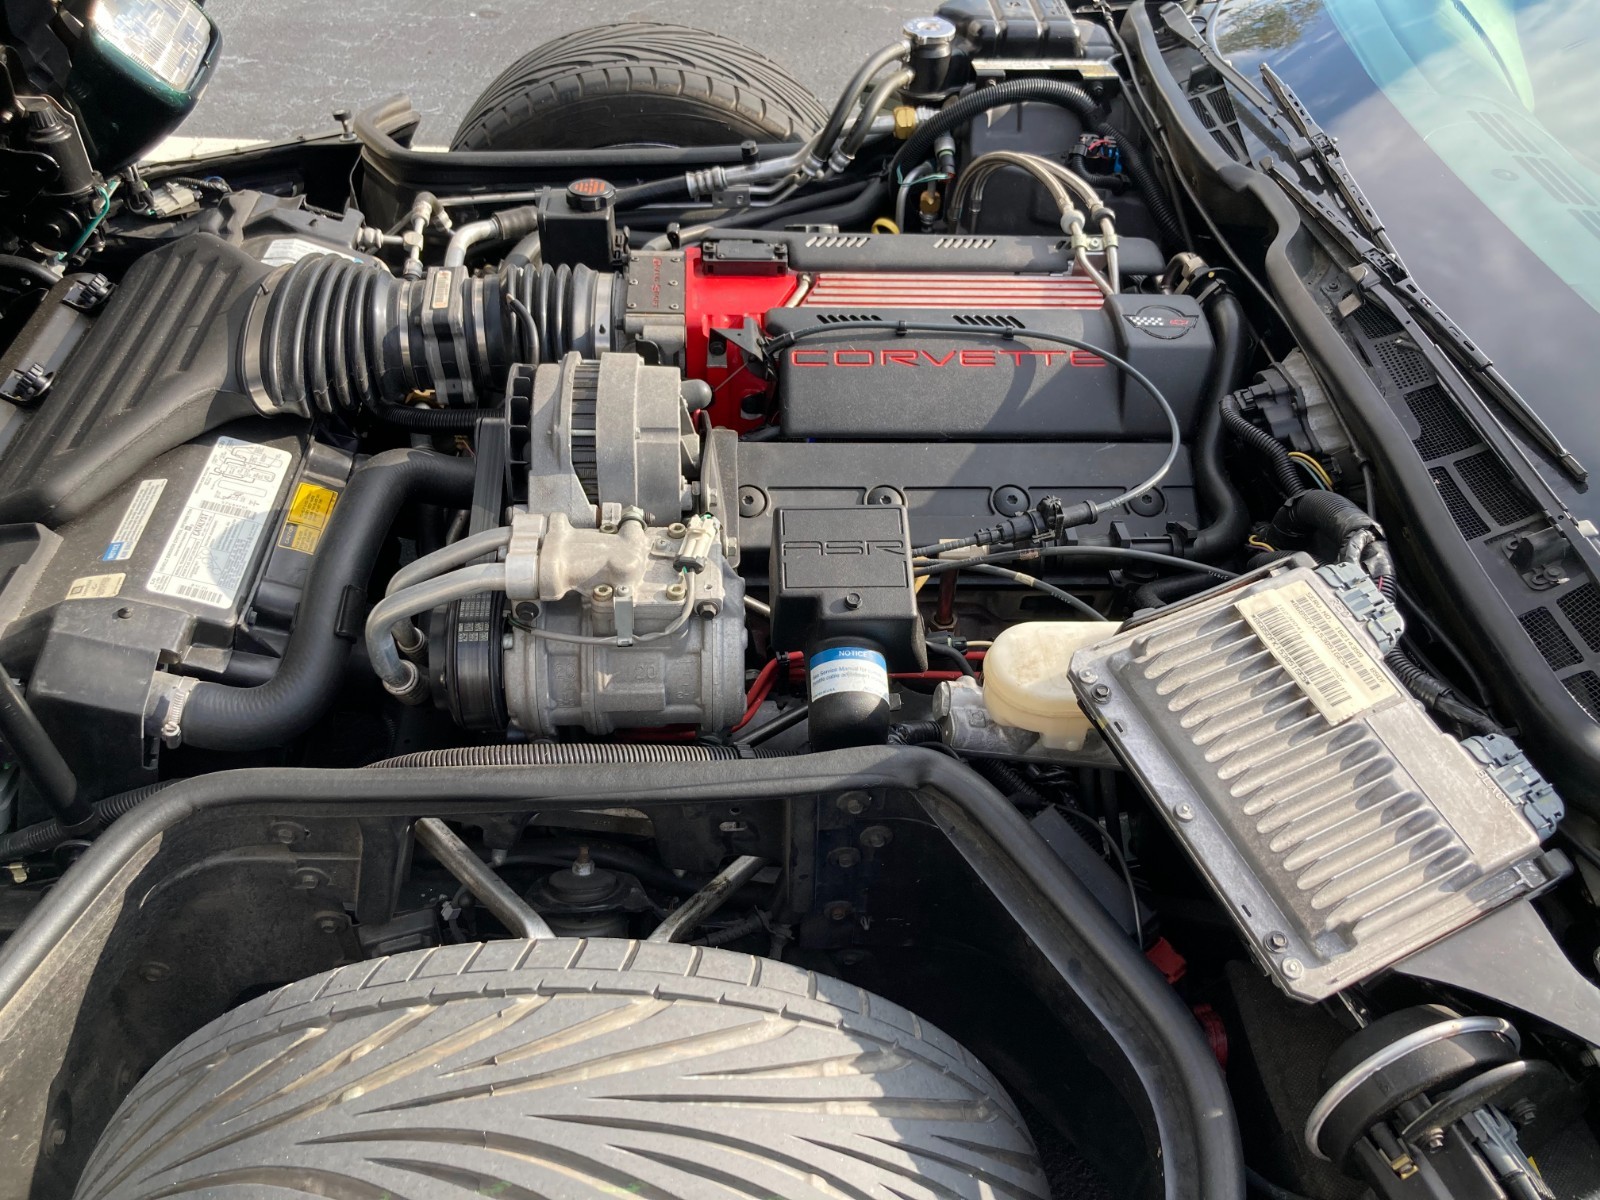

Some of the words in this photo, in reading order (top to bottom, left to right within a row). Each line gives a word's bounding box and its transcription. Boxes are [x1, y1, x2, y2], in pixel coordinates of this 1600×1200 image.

[791, 348, 1108, 369] CORVETTE
[191, 512, 208, 536] CATALYST
[782, 539, 906, 557] ASR
[839, 650, 868, 658] NOTICE
[820, 667, 837, 676] Service
[1475, 768, 1513, 810] BLACK
